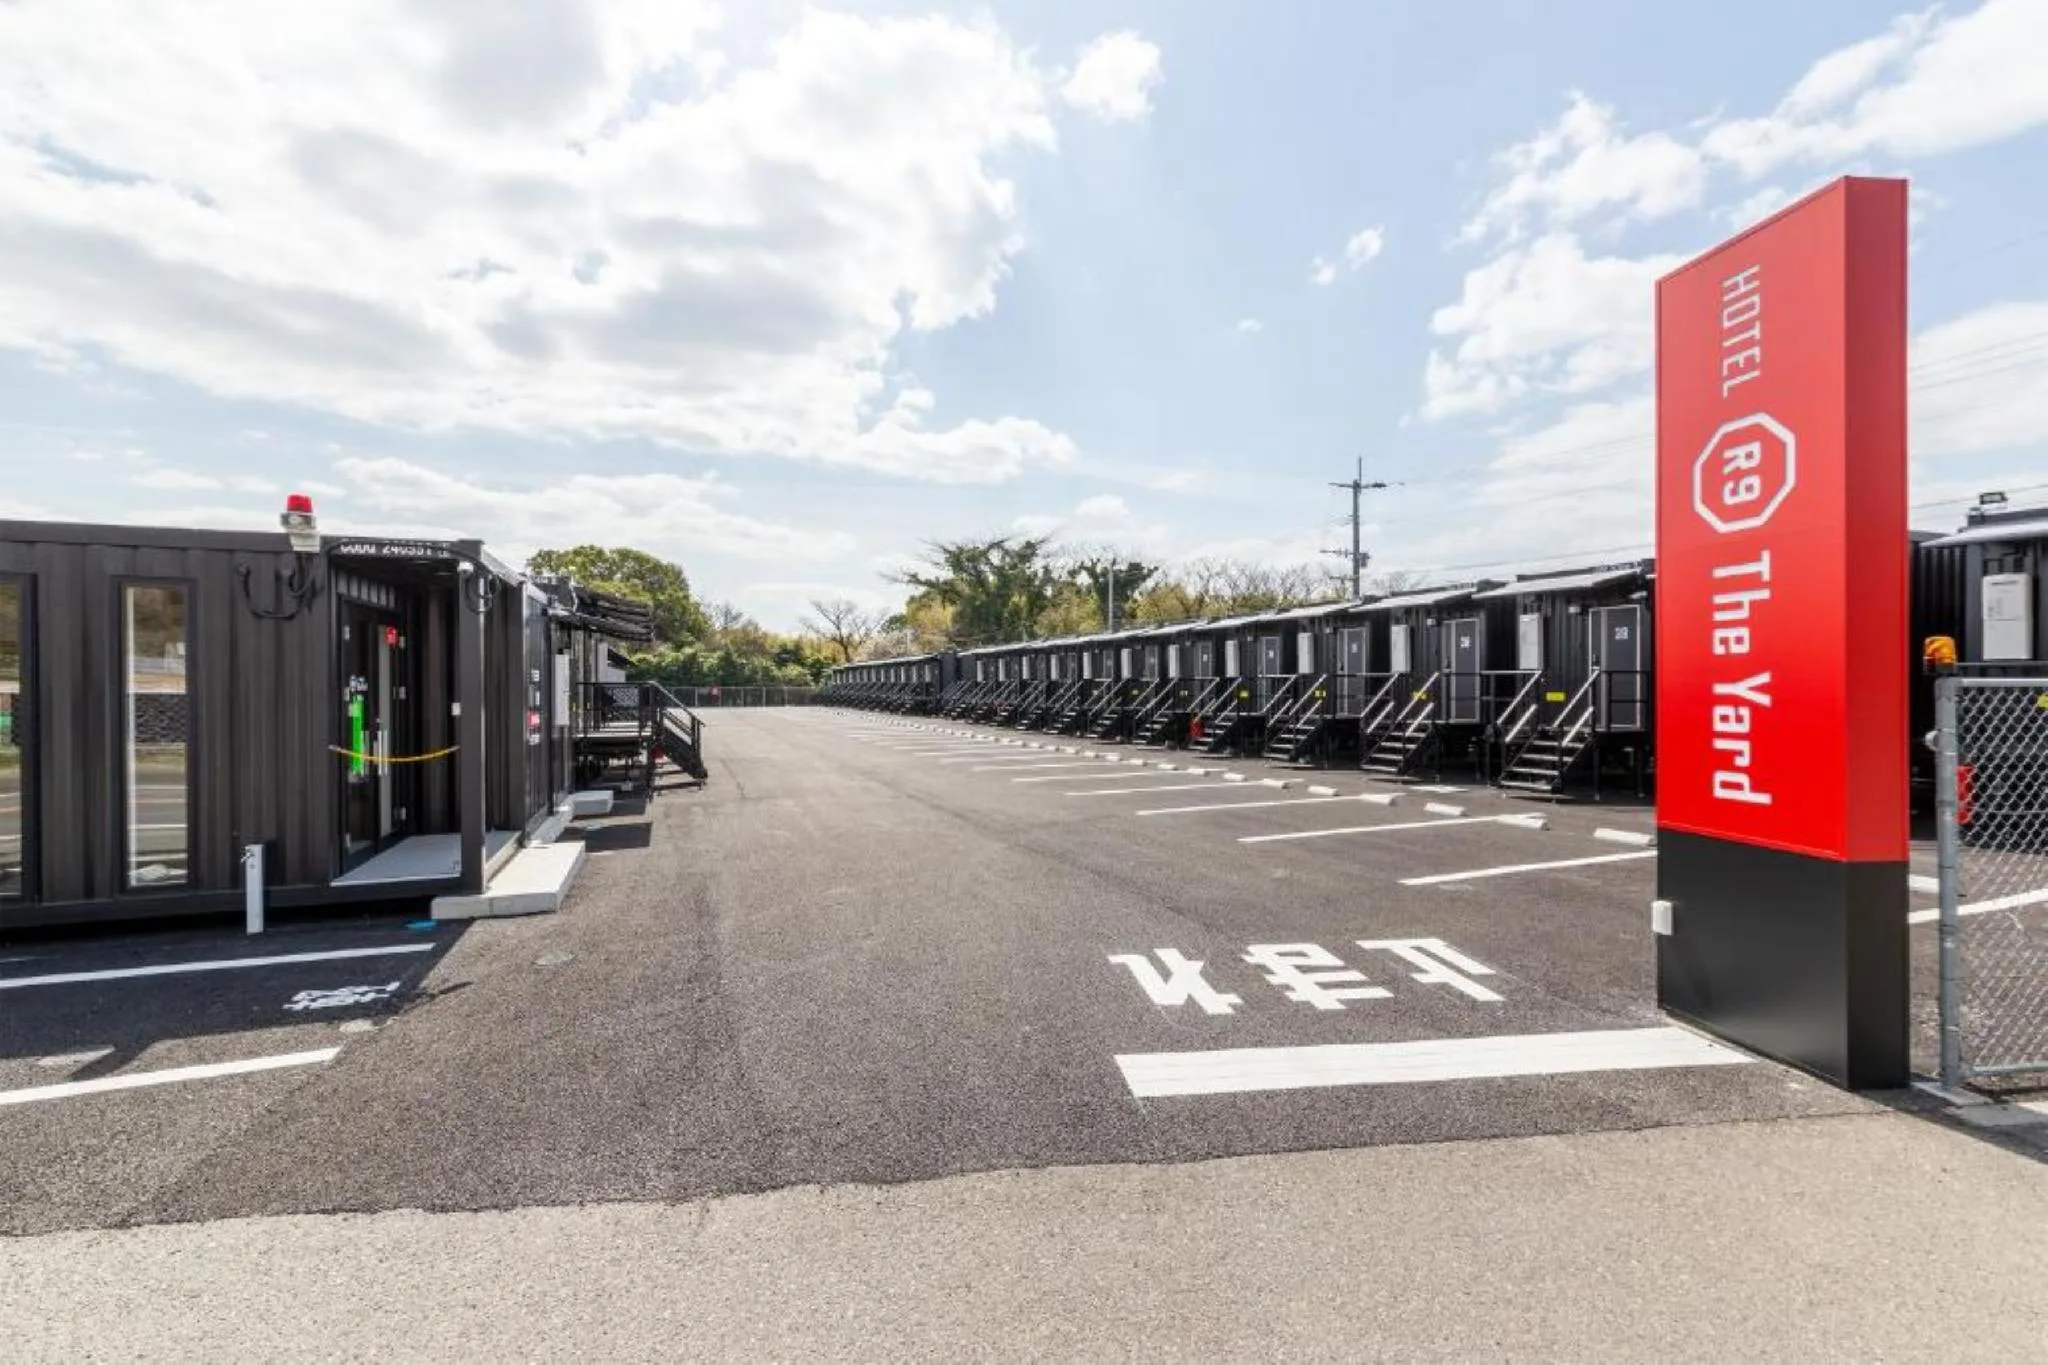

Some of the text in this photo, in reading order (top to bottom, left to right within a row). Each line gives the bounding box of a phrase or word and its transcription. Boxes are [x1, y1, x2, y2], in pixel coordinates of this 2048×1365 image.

[1712, 264, 1772, 805] HOTEL R9 The Yard
[1107, 938, 1506, 1014] 止まれ
